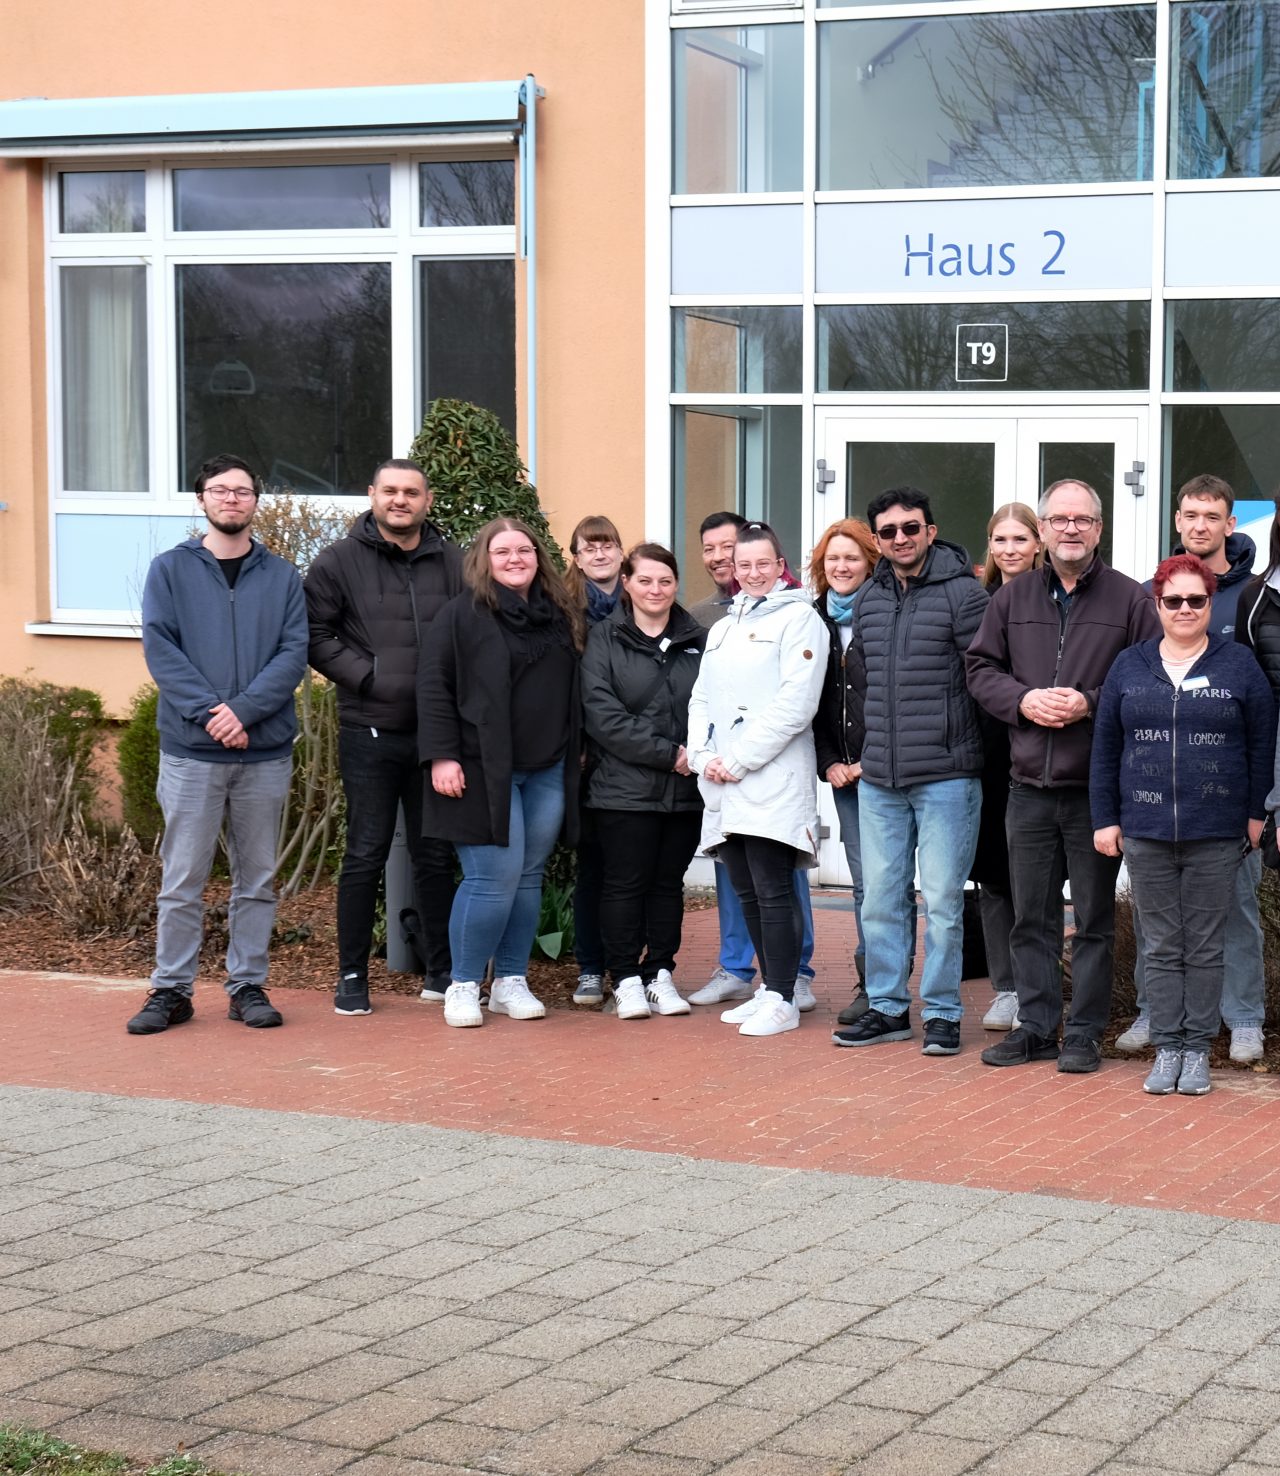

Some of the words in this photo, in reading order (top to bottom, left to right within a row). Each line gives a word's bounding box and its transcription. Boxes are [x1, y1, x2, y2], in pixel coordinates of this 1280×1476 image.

[904, 233, 1016, 277] Haus
[1041, 230, 1066, 275] 2
[966, 342, 996, 365] T9
[1192, 688, 1232, 699] PARIS
[1188, 732, 1226, 746] LONDON
[1133, 790, 1163, 804] LONDON
